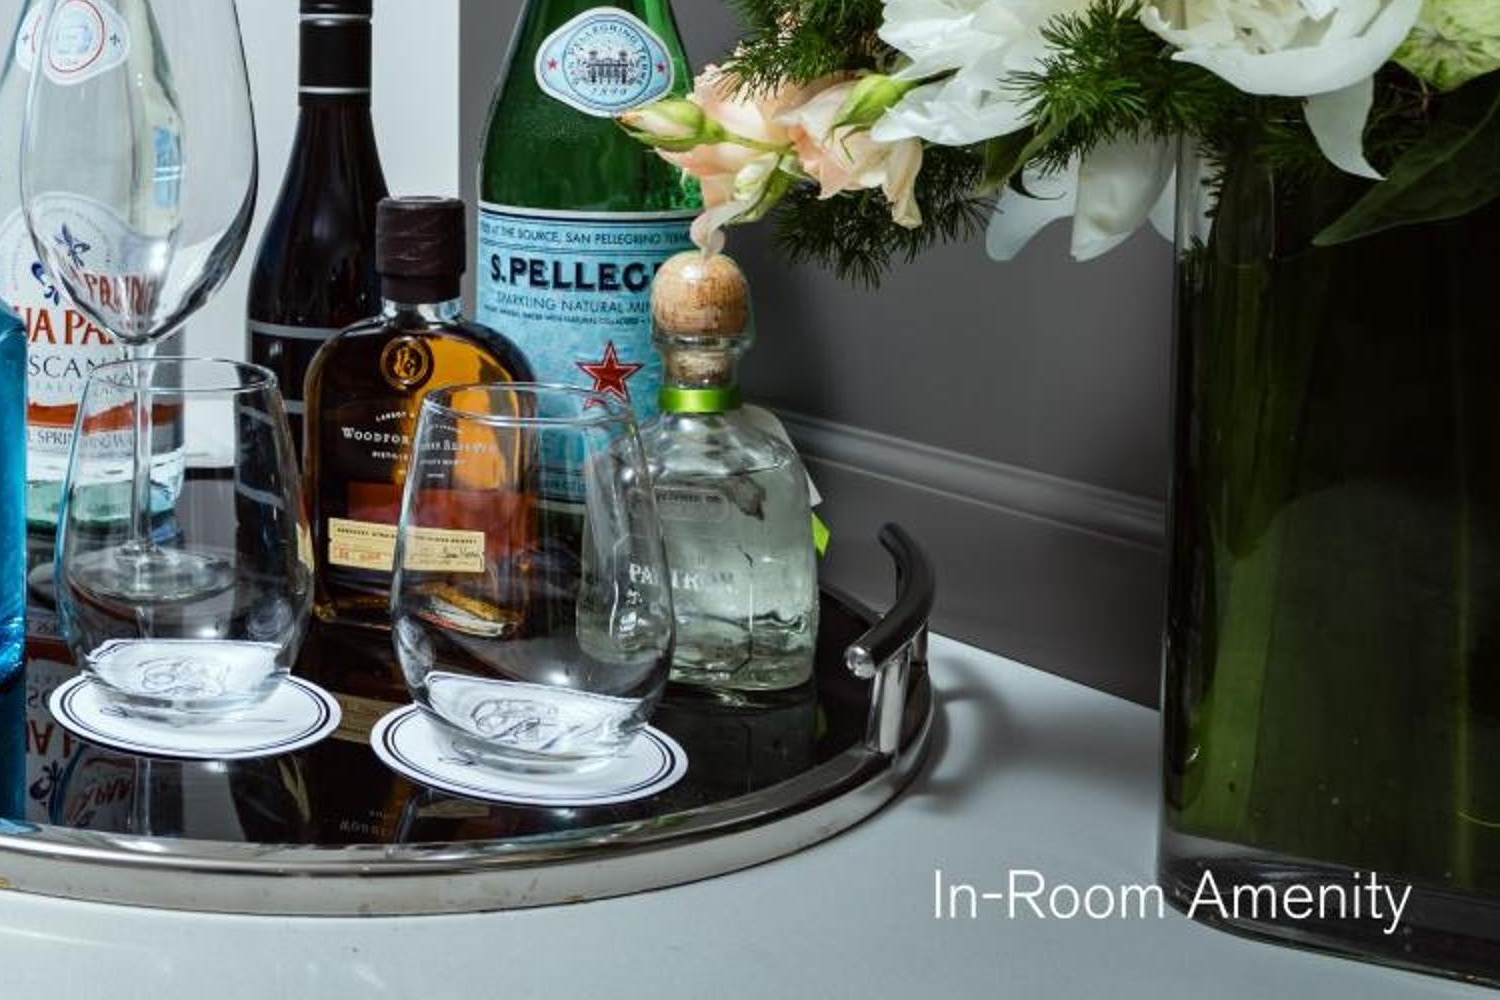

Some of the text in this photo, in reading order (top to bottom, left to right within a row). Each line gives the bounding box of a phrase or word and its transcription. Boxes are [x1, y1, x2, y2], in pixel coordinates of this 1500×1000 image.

[518, 228, 561, 243] SOURCE,
[566, 232, 591, 245] SAN
[595, 233, 660, 246] PELLEGRINO
[491, 253, 660, 294] S.PELLEG
[495, 291, 556, 311] PARKLING
[561, 300, 624, 314] NATURAL
[341, 426, 410, 446] WOODFOR
